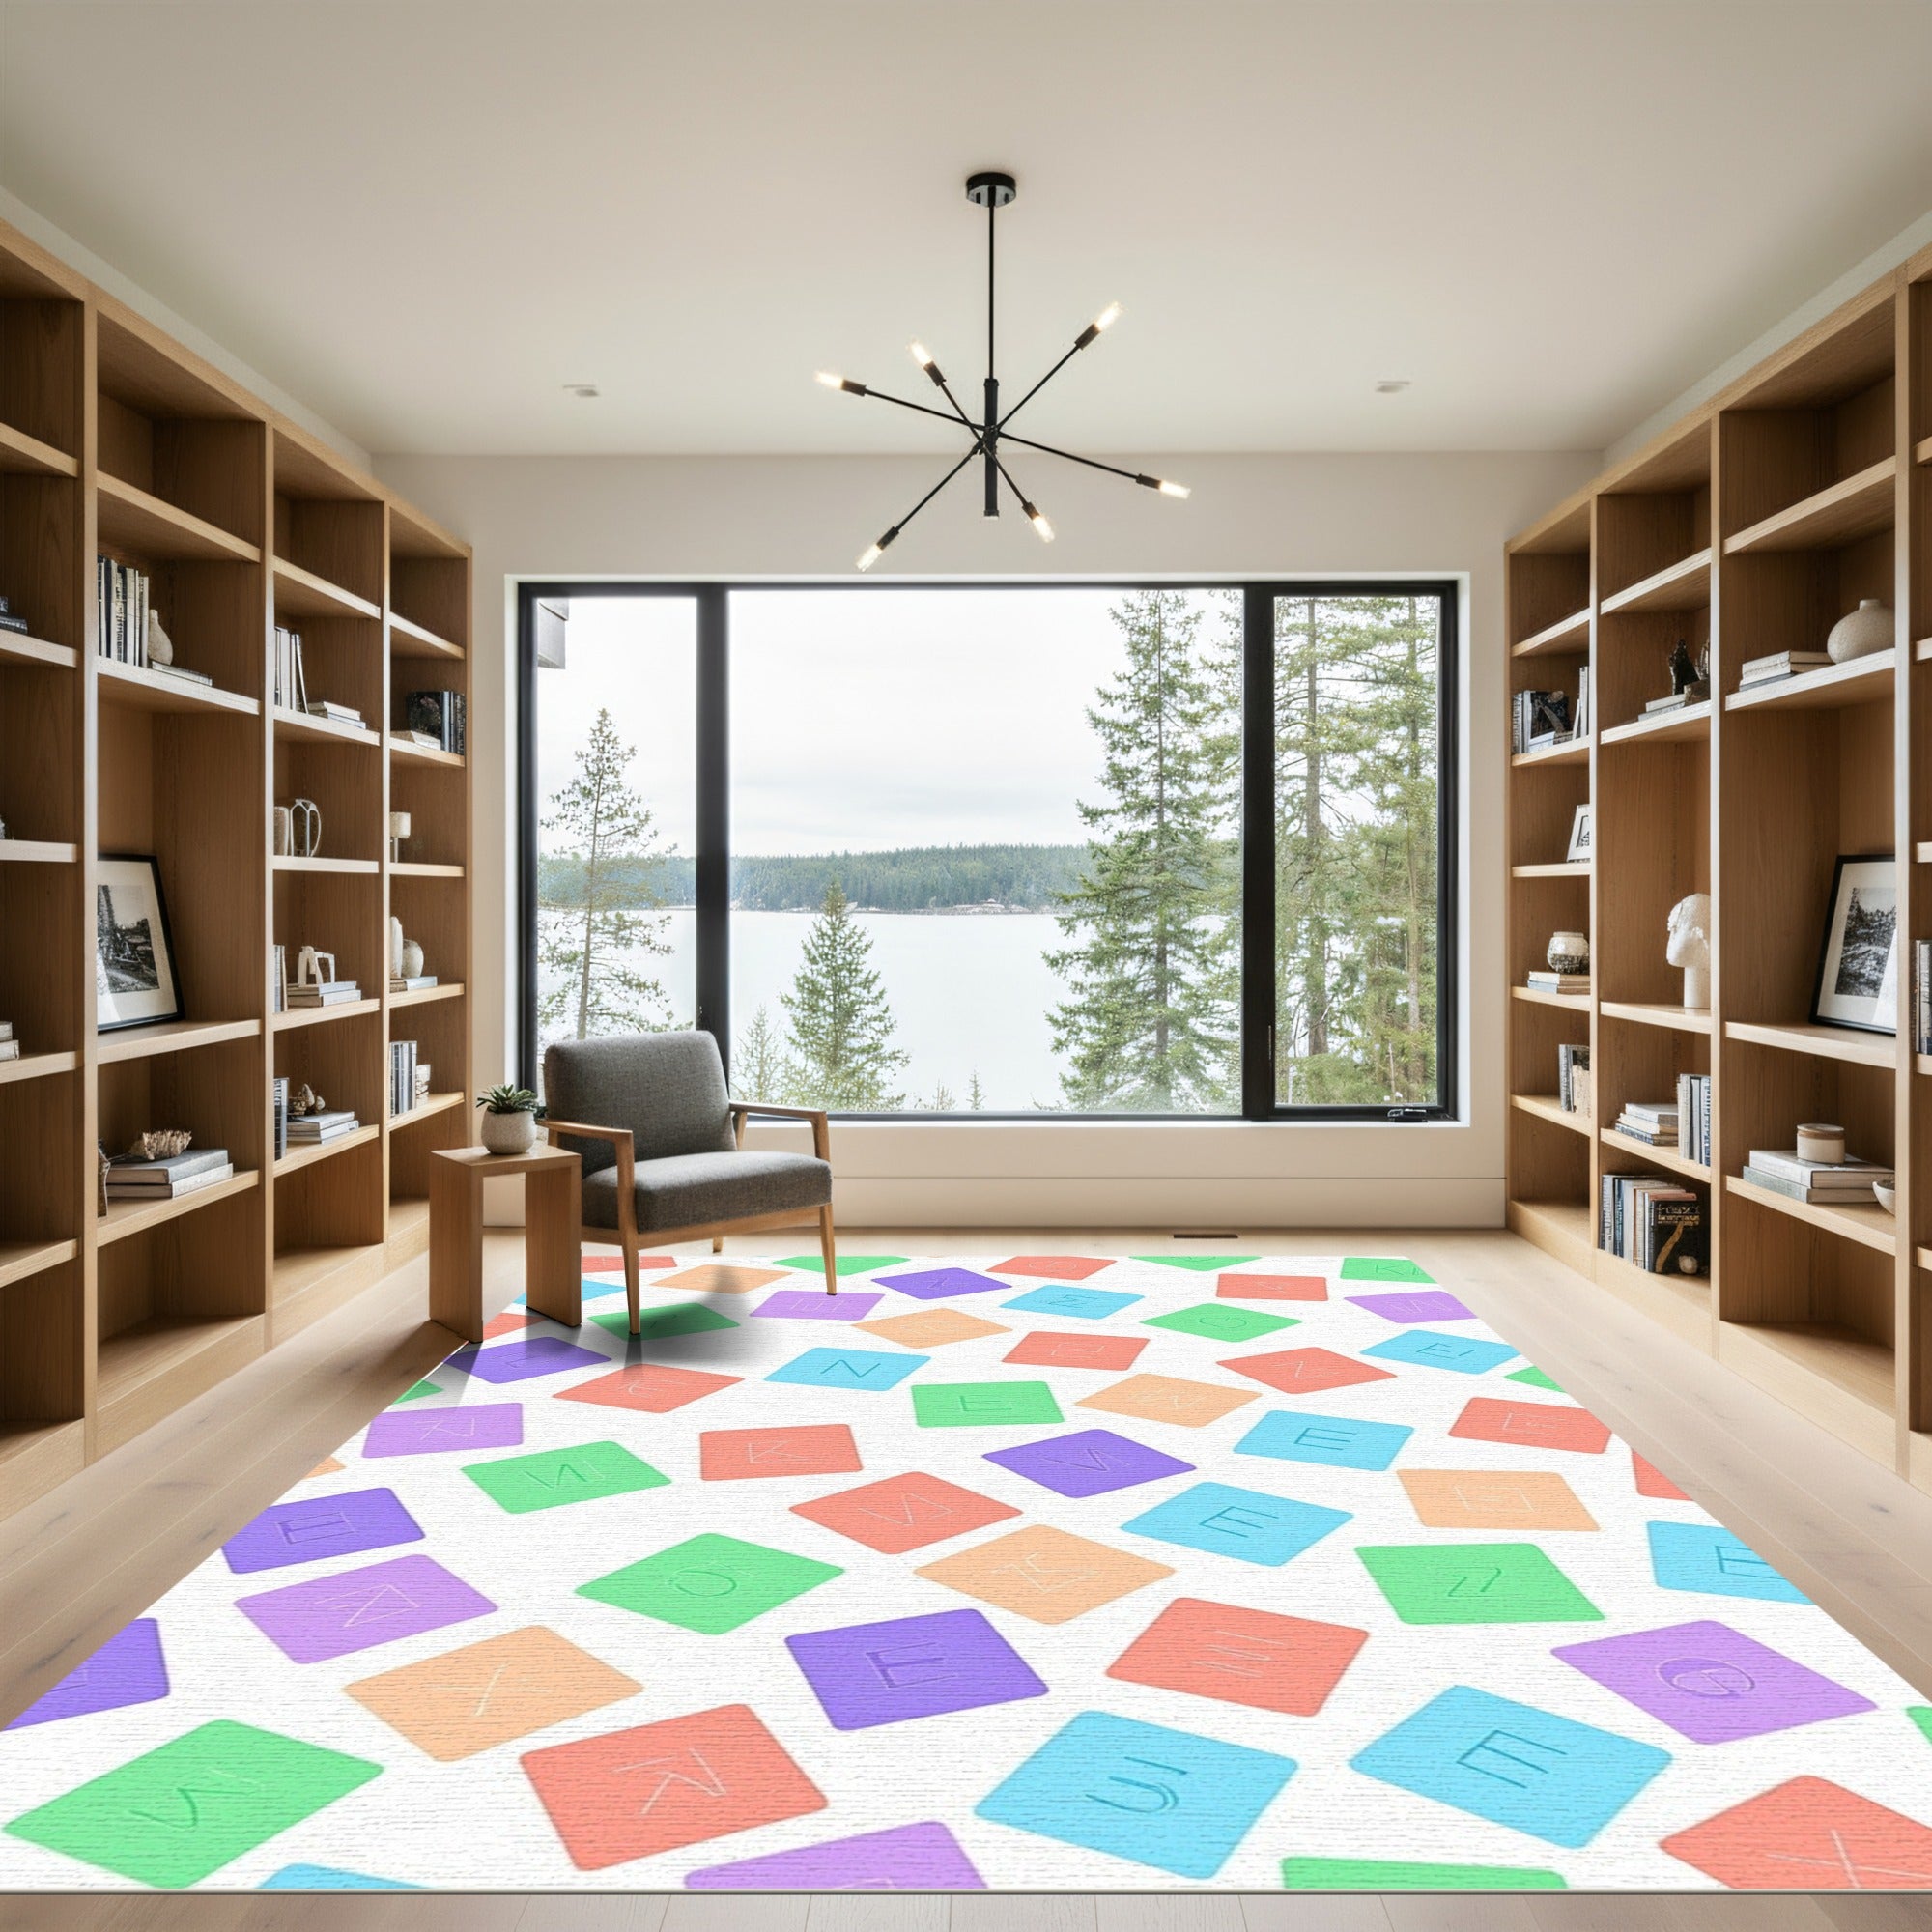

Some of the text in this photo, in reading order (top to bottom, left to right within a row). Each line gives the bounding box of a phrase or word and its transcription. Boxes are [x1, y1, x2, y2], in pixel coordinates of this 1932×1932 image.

[1293, 1426, 1358, 1452] E
[1199, 1505, 1280, 1539] E
[1455, 1728, 1569, 1790] E
